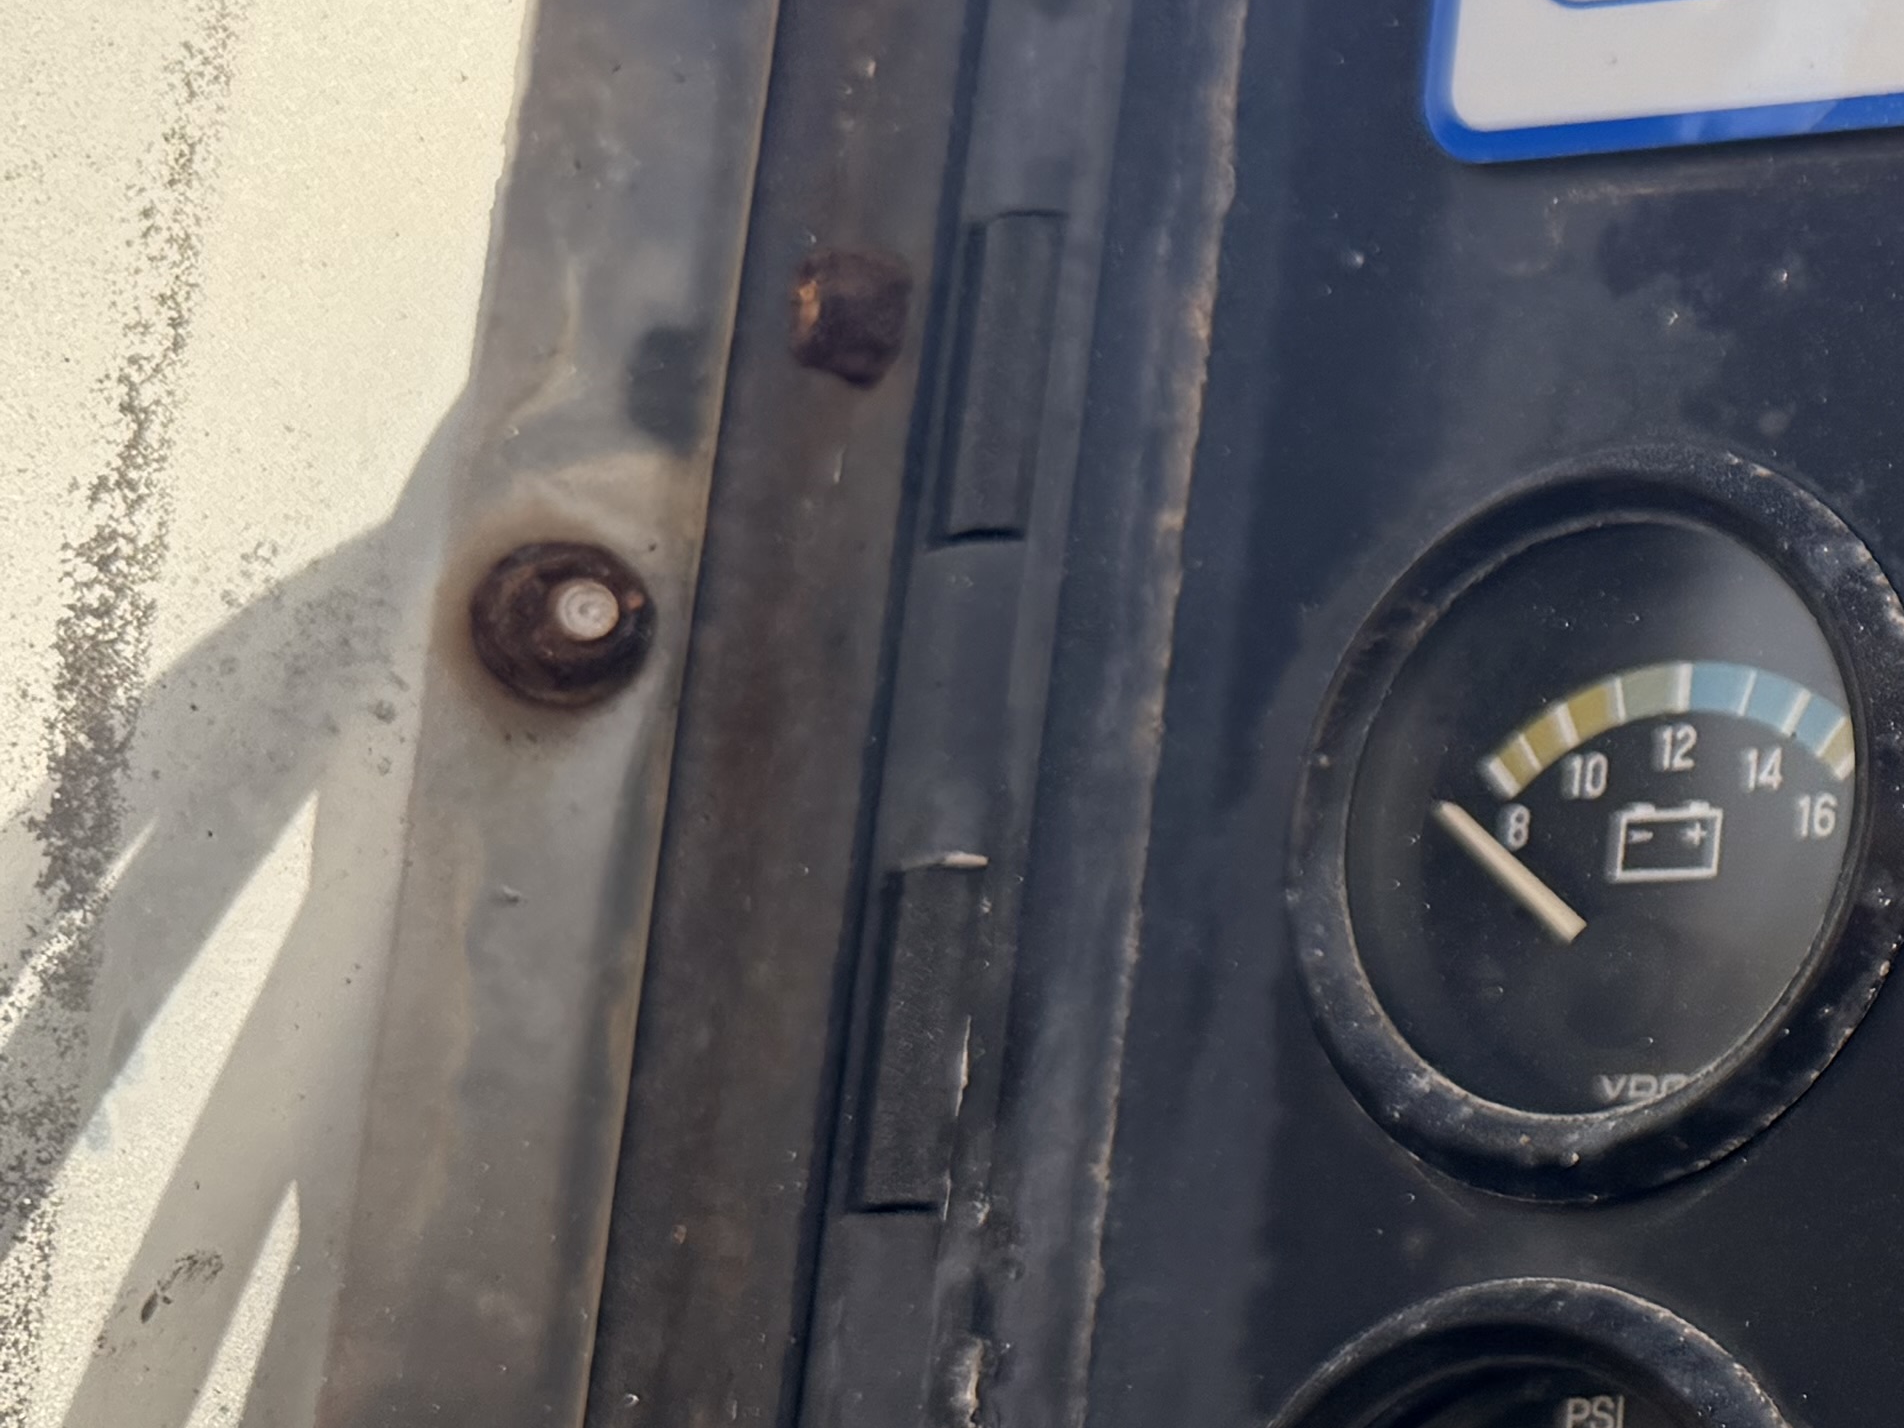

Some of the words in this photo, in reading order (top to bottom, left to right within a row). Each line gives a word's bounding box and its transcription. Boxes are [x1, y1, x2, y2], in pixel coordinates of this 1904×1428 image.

[1661, 727, 1696, 770] 12
[1747, 748, 1783, 791] 14
[1571, 752, 1608, 798] 10
[1507, 804, 1530, 849] 8
[1800, 795, 1836, 839] 16
